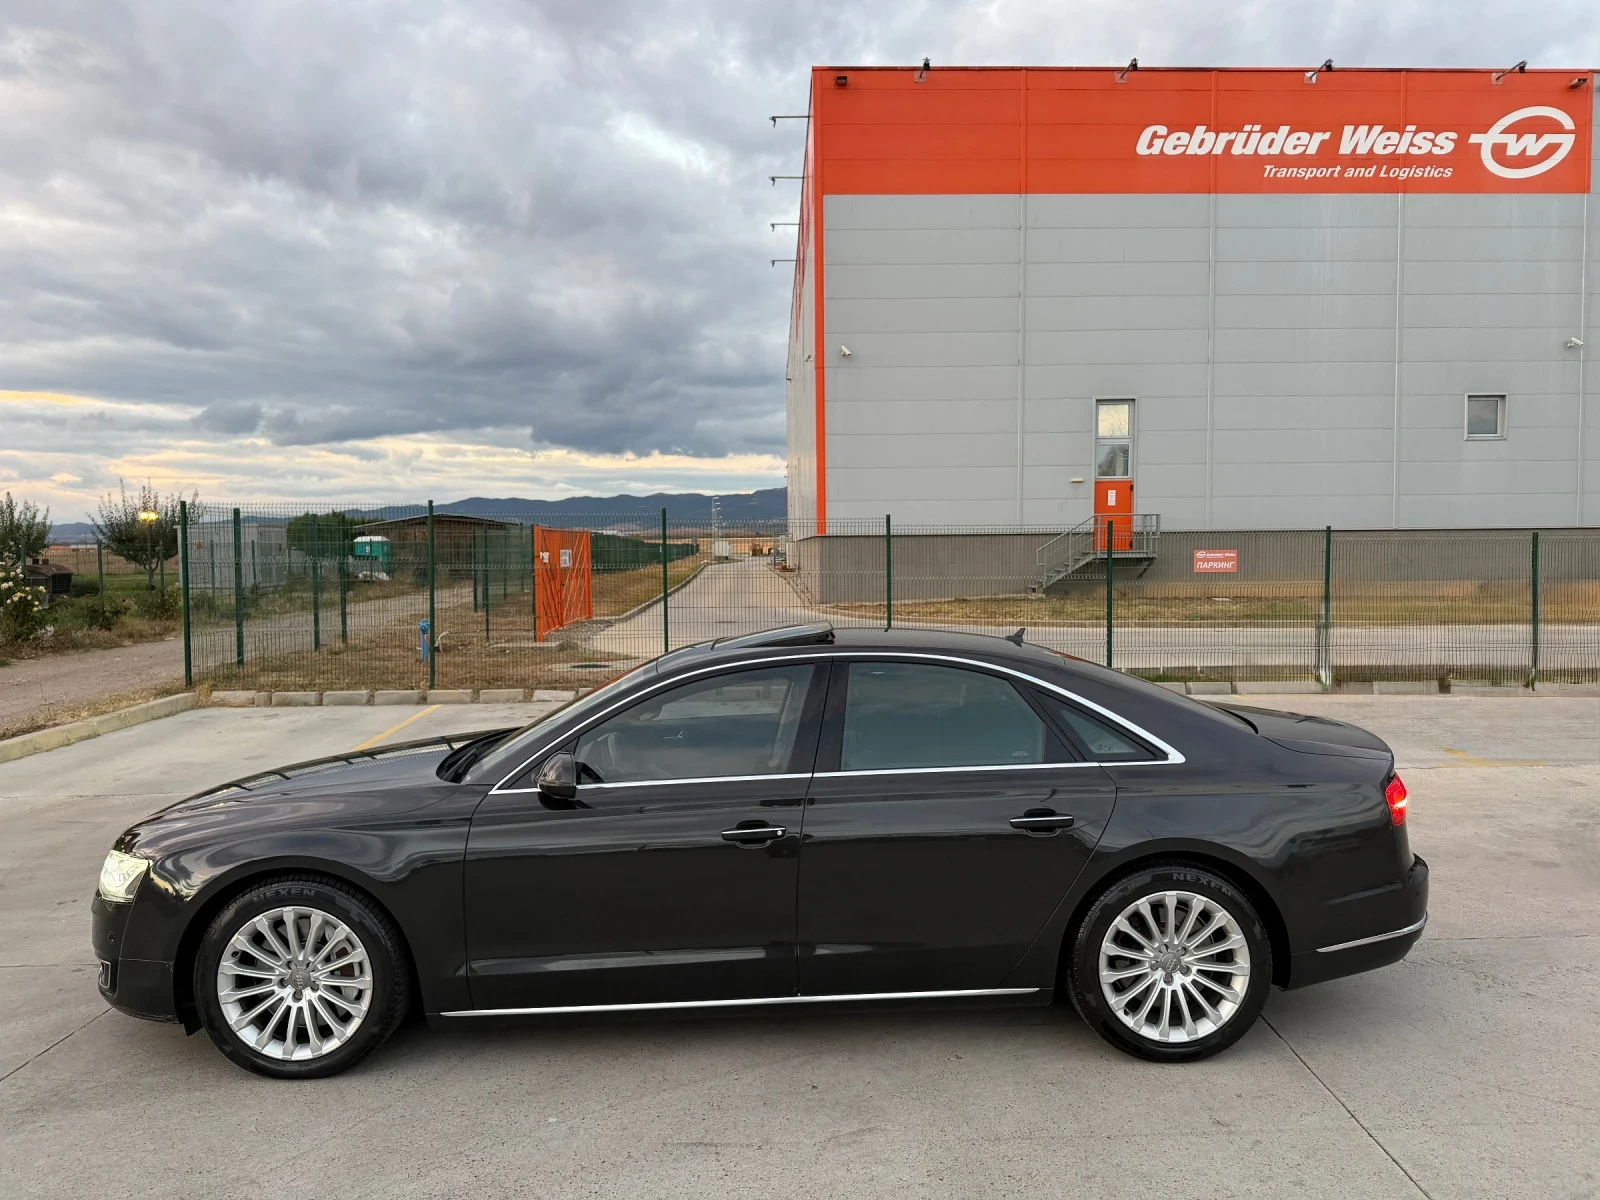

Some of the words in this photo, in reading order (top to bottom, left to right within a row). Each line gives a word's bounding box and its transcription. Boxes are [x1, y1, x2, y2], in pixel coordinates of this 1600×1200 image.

[1136, 124, 1331, 156] Gebrüder
[1338, 124, 1458, 155] Weiss
[1263, 164, 1341, 180] Transport
[1343, 165, 1377, 178] and
[1379, 165, 1453, 180] Logistics
[1196, 561, 1236, 569] ПАРКИНГ
[1172, 872, 1232, 896] NEXEN
[252, 888, 316, 903] NEXEN
